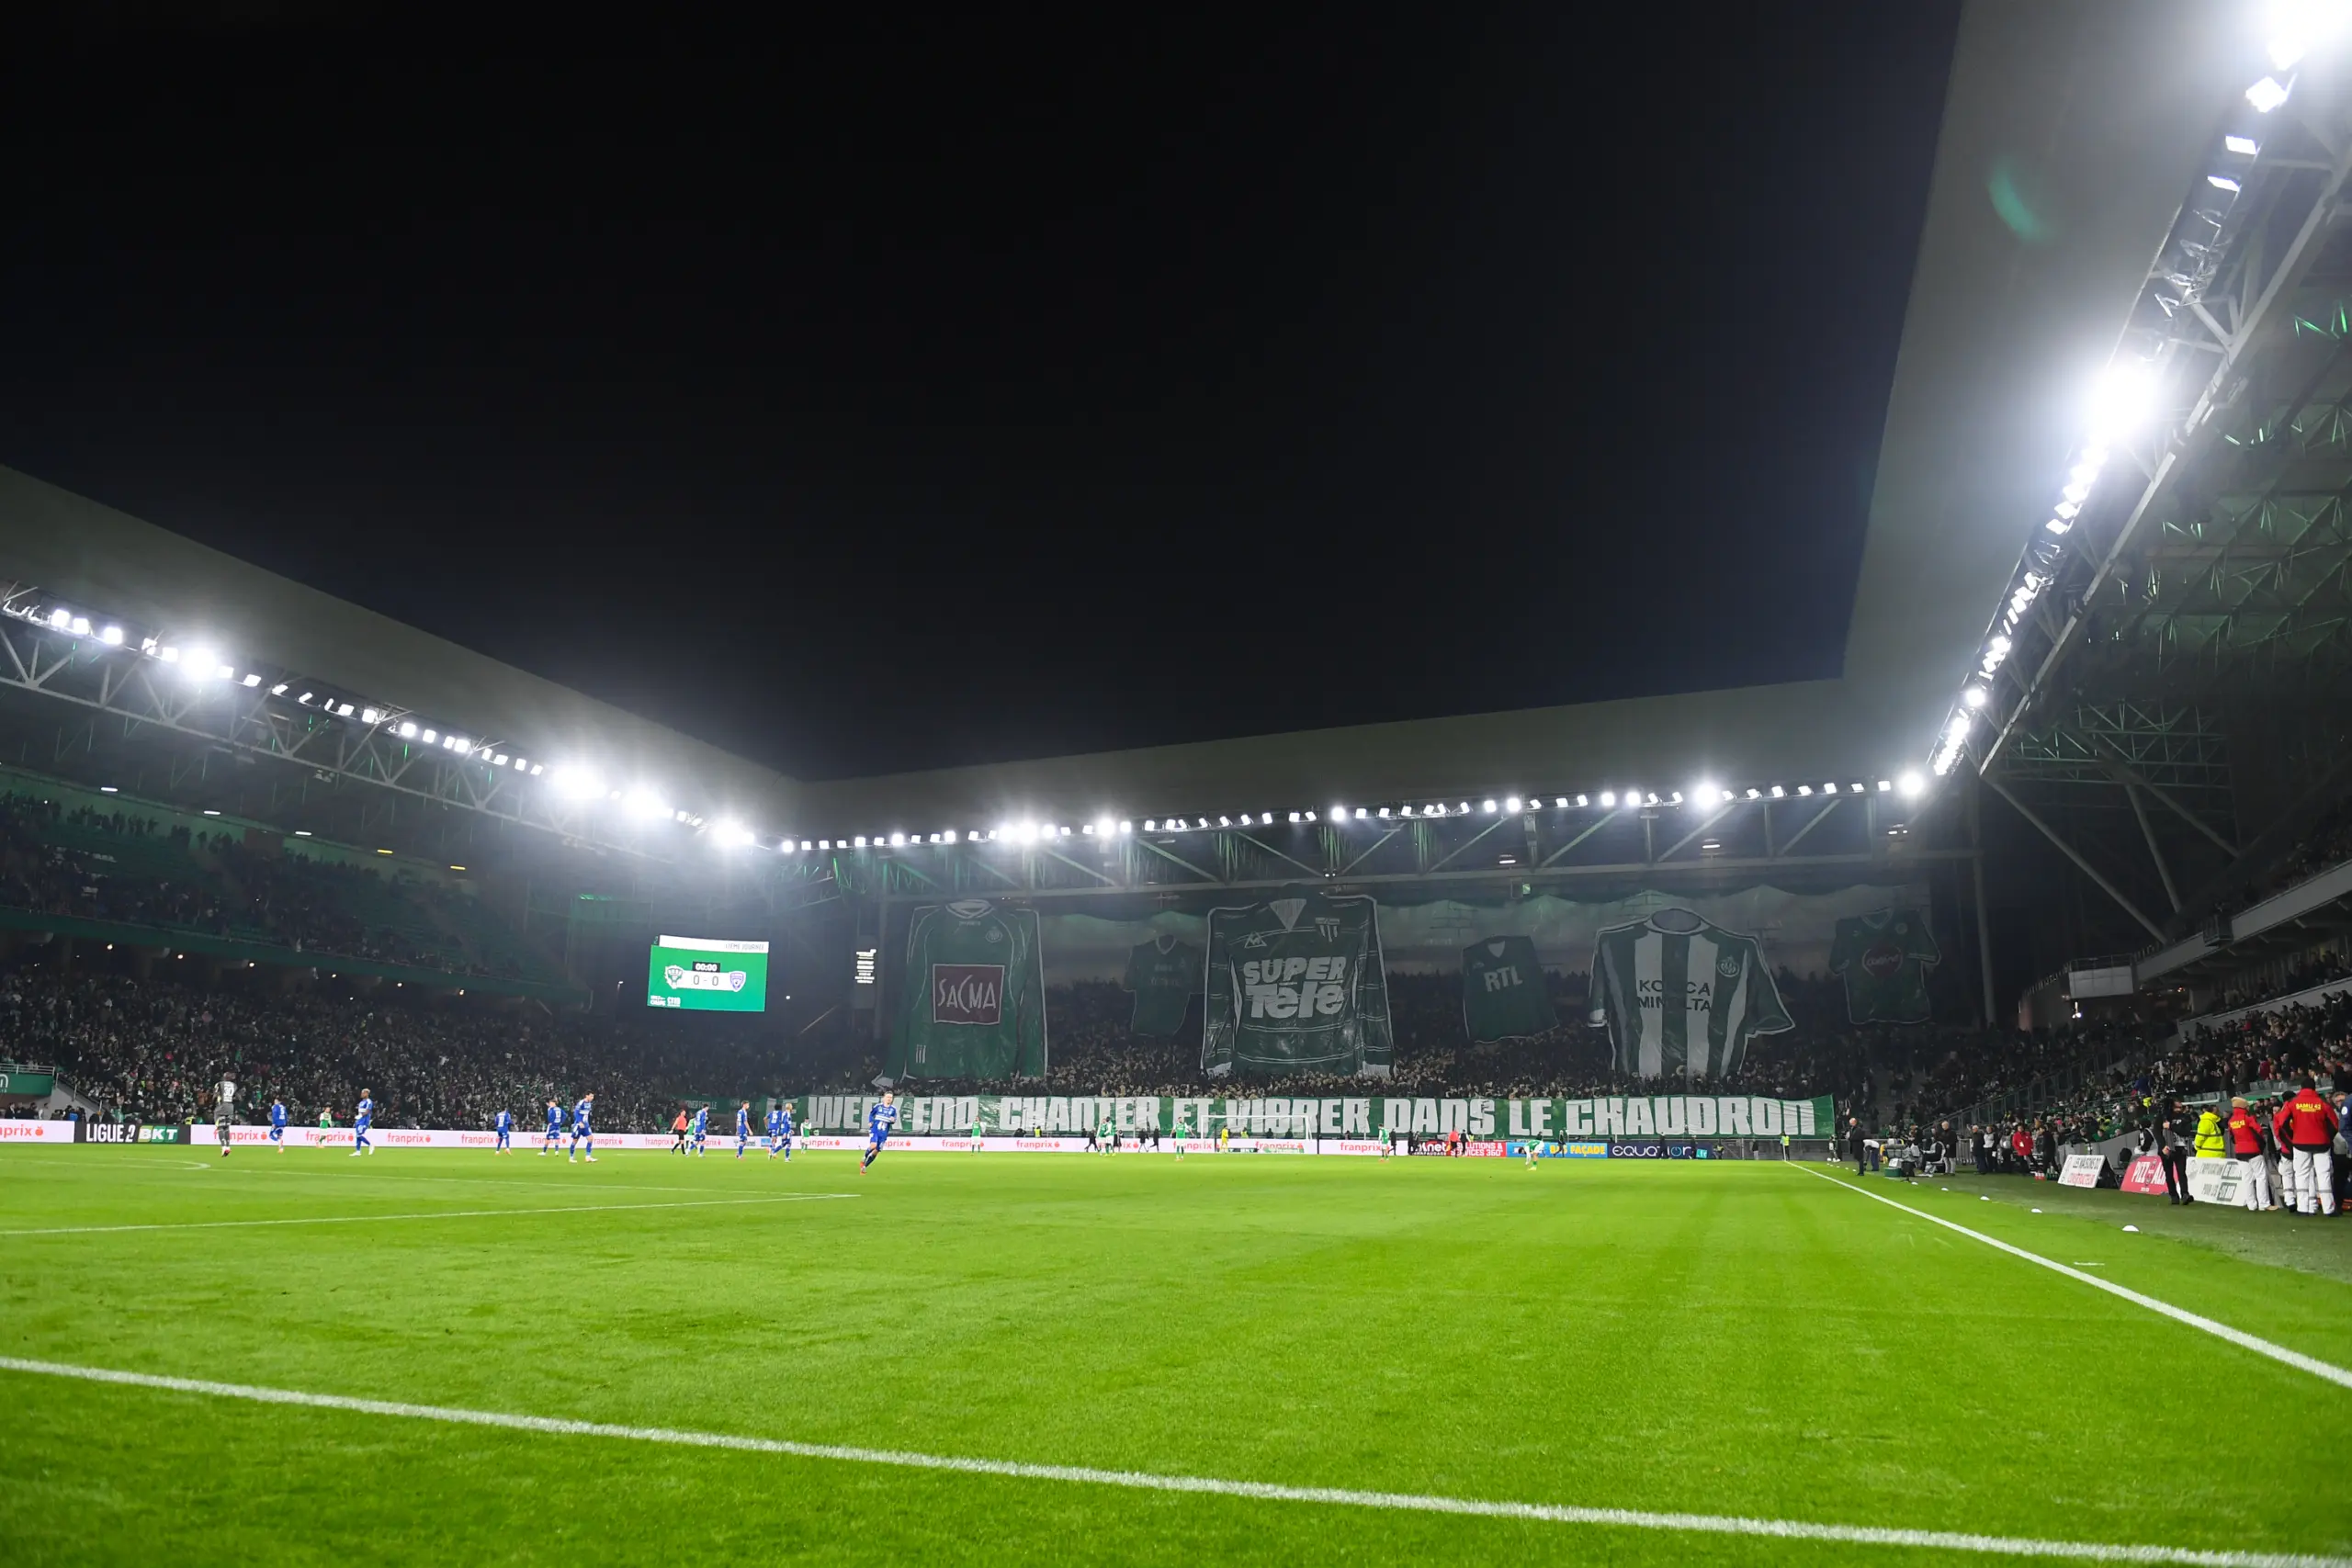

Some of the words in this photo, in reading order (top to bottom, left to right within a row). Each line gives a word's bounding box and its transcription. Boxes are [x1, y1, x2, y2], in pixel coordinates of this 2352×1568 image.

[1243, 956, 1347, 986] SUPER
[1484, 965, 1523, 992] RTL
[694, 975, 700, 985] 0
[712, 976, 718, 986] 0
[1639, 979, 1711, 997] KOCA
[938, 974, 997, 1013] SACMA
[999, 1096, 1160, 1131] CHANTER
[1384, 1098, 1495, 1135] DANS
[1509, 1099, 1554, 1136] LE
[1566, 1096, 1815, 1135] CHAUDRON
[86, 1123, 124, 1143] LIGUE
[125, 1124, 136, 1143] 2
[139, 1127, 178, 1141] BKT
[306, 1131, 346, 1143] fraprix
[387, 1133, 424, 1145] franprix
[461, 1134, 494, 1145] franprix
[1016, 1140, 1053, 1149] franprix
[1340, 1143, 1382, 1153] franprix
